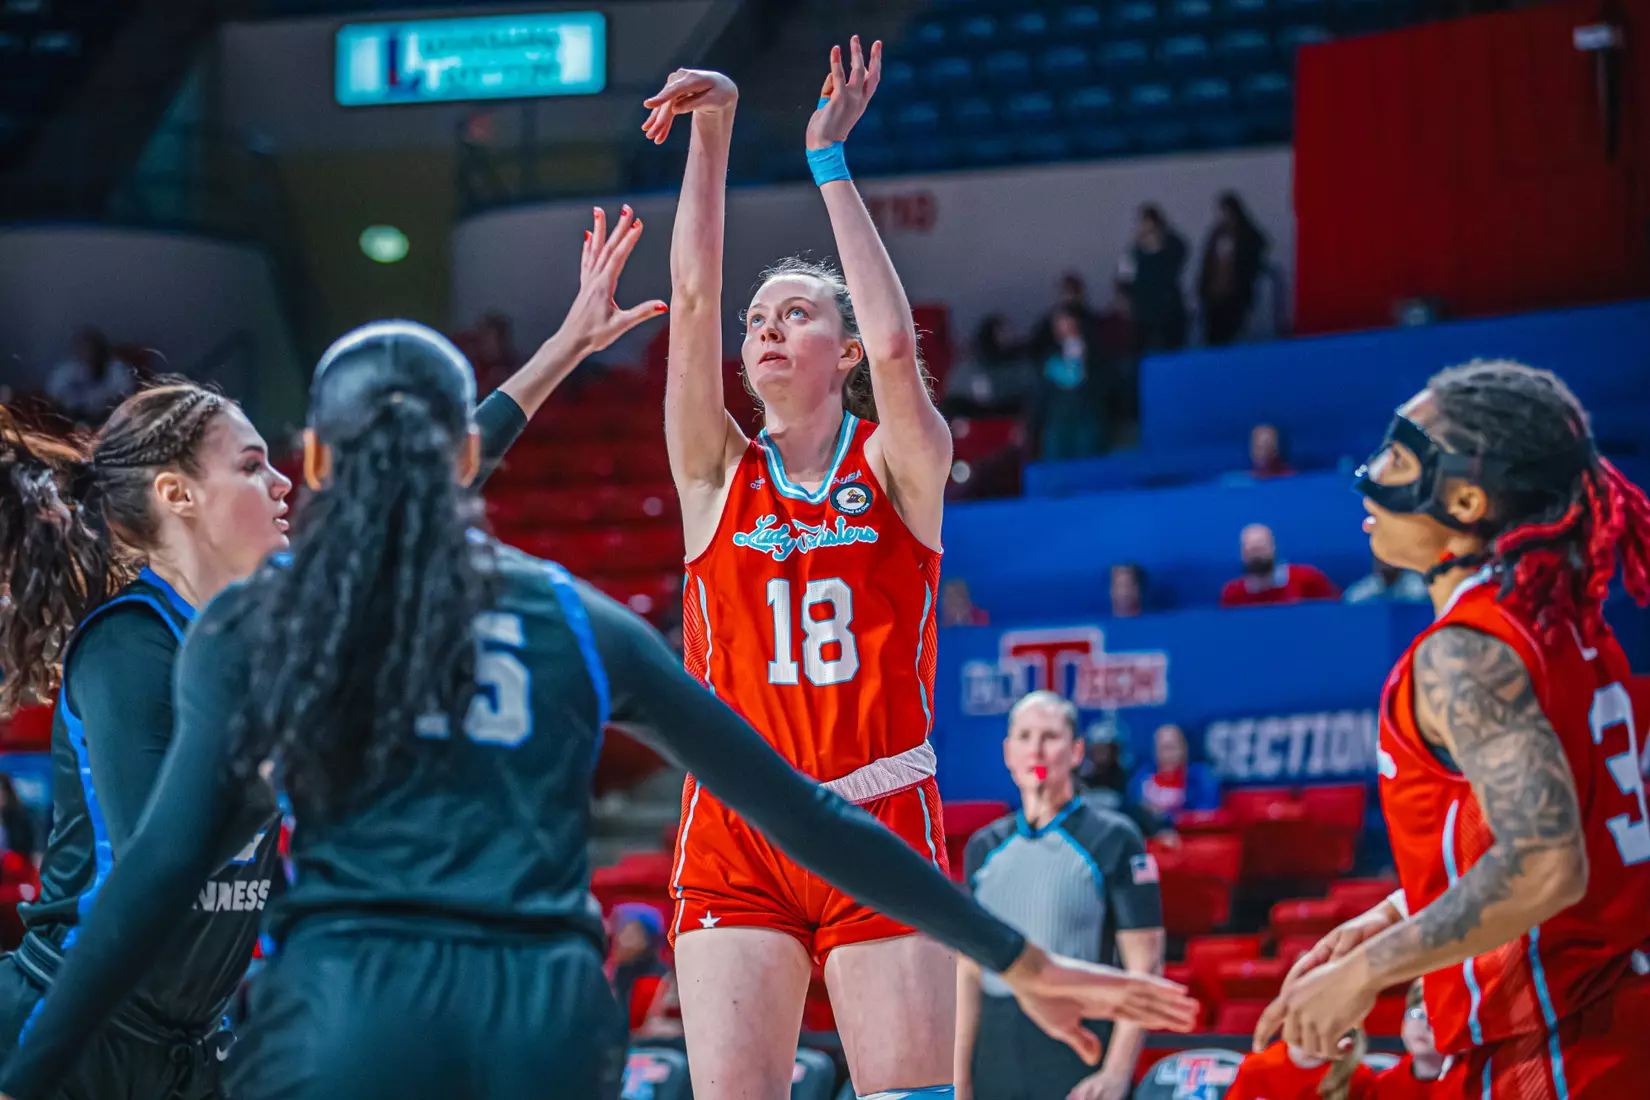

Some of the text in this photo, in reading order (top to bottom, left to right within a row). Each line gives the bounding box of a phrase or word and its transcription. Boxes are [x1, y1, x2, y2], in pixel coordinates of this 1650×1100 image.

[733, 514, 797, 561] Lady
[414, 611, 534, 747] 5
[766, 577, 860, 687] 18
